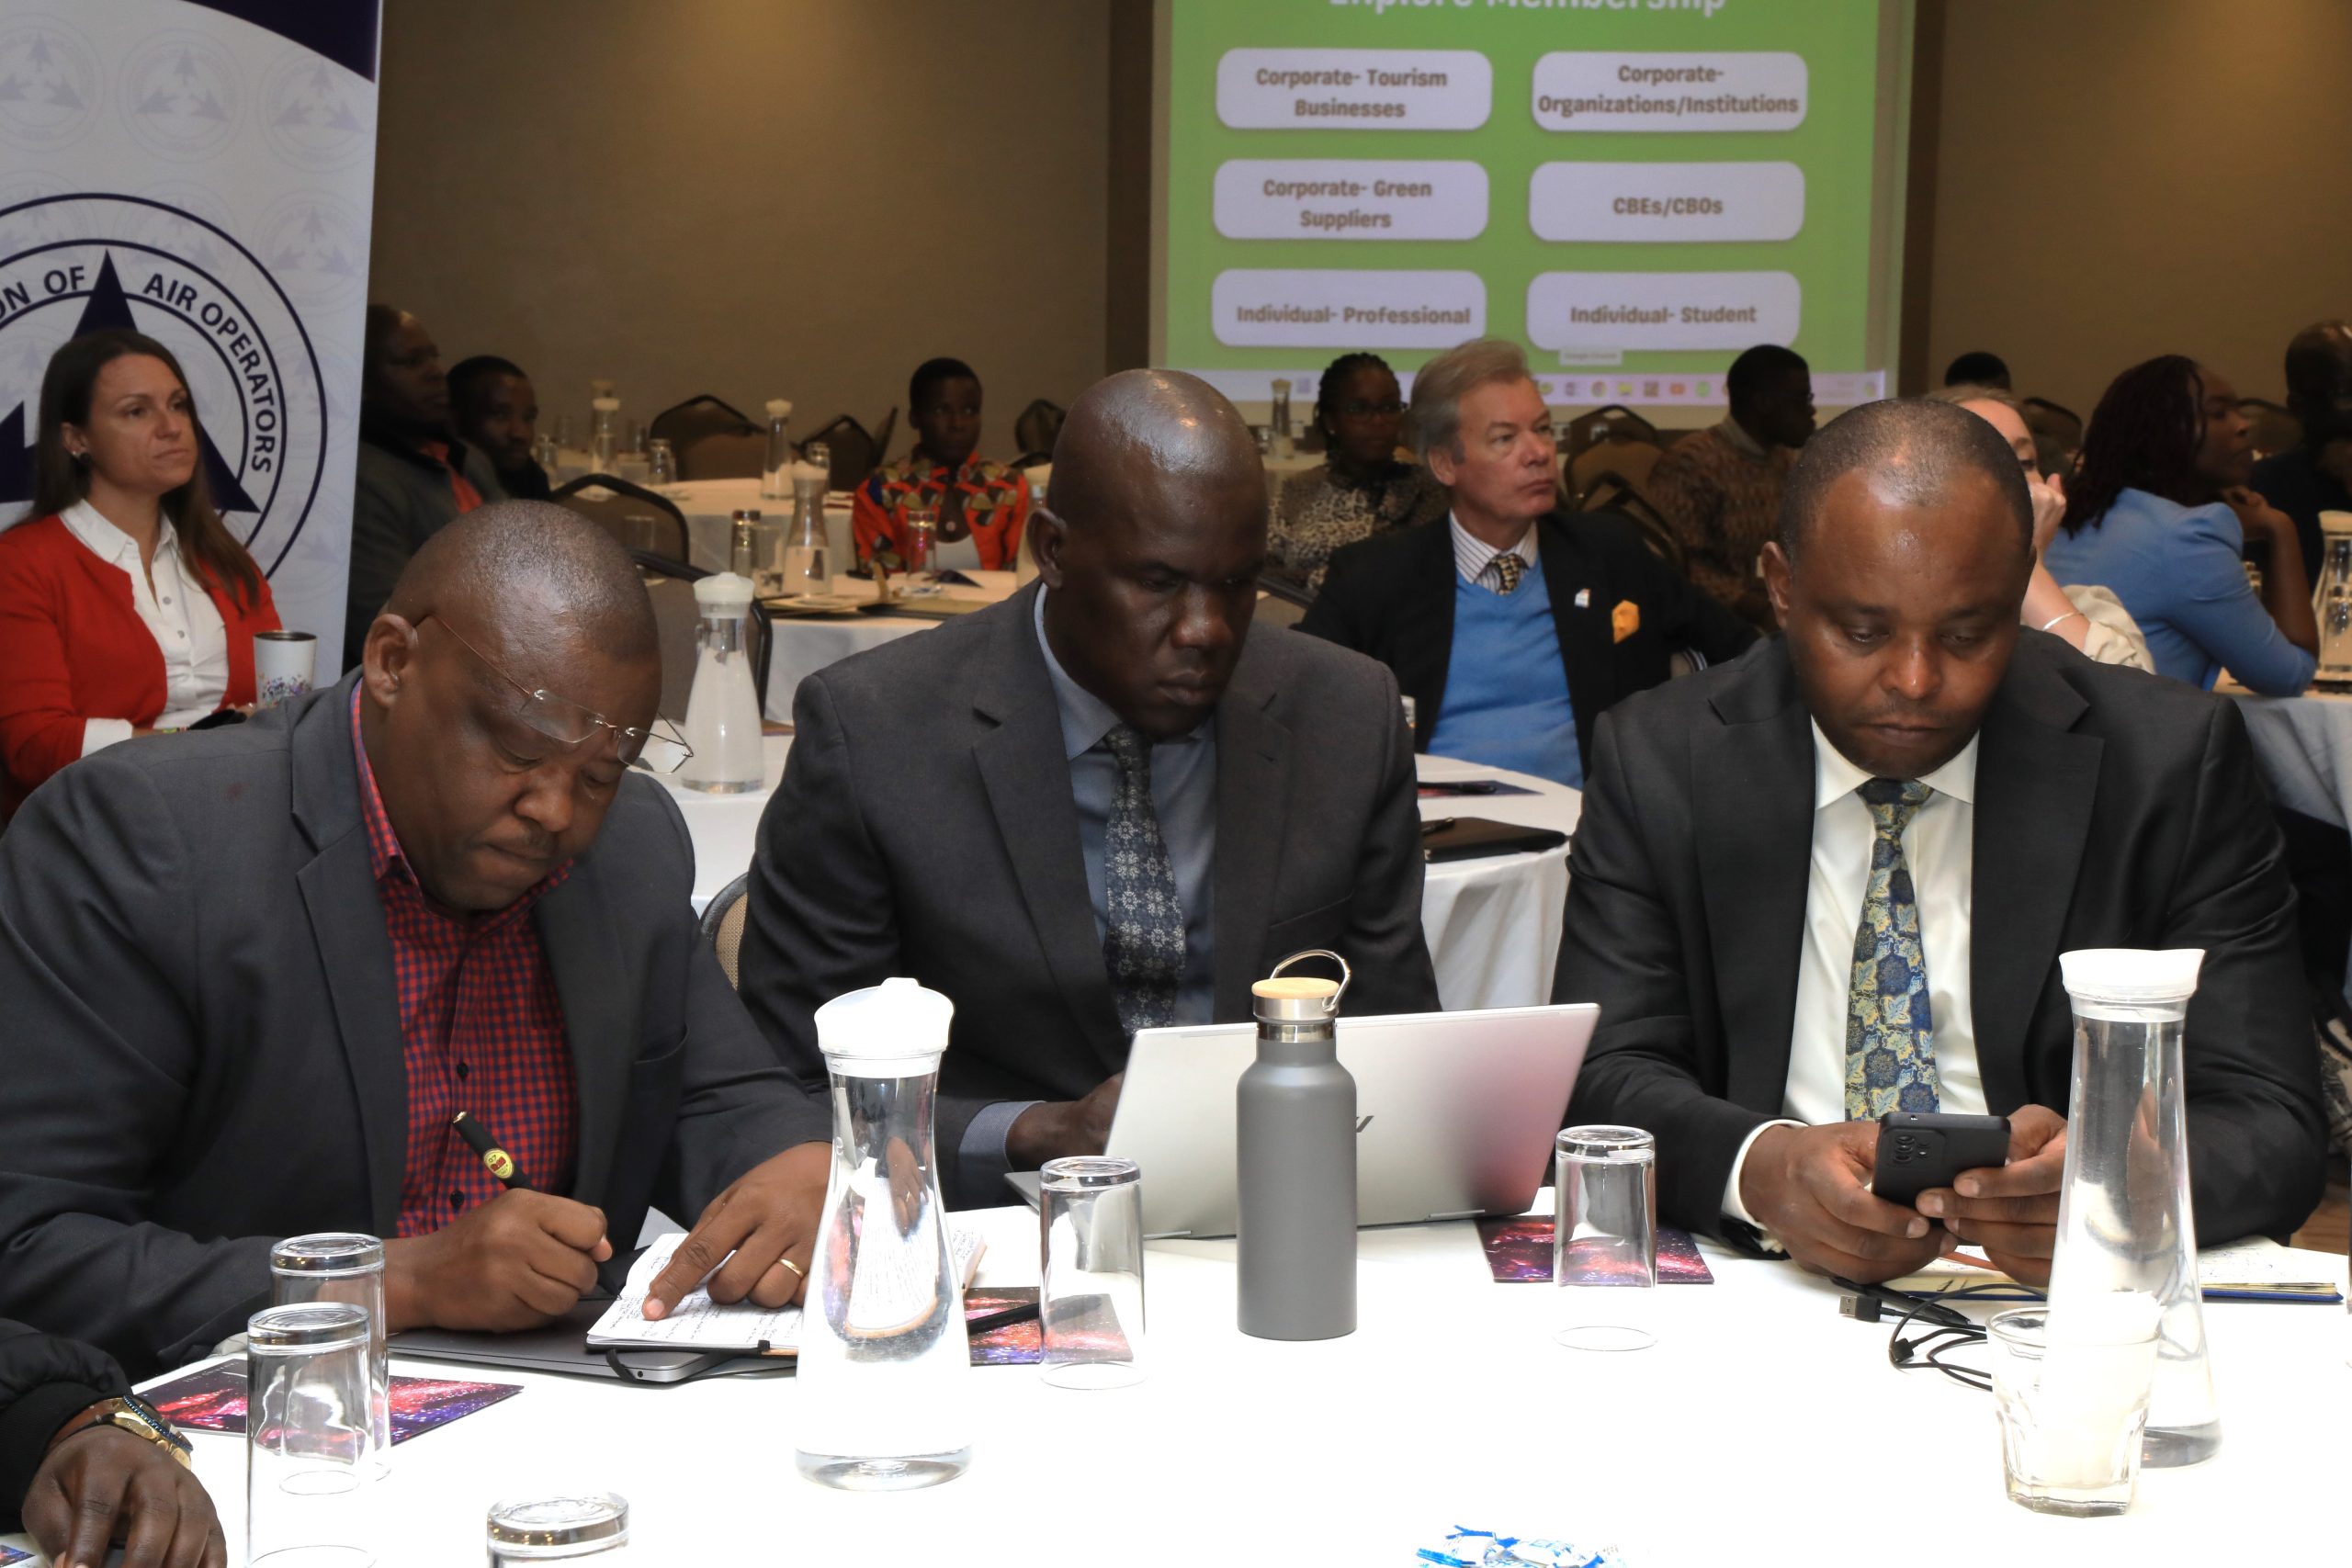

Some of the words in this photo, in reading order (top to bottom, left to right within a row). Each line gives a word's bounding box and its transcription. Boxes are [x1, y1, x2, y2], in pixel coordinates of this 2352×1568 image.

[1255, 67, 1361, 90] Corporate-
[1367, 67, 1448, 87] Tourism
[1618, 64, 1724, 86] Corporate-
[1294, 97, 1407, 118] Businesses
[1538, 94, 1800, 118] Organizations/Institutions
[1262, 178, 1368, 200] Corporate-
[1374, 179, 1433, 197] Green
[1612, 197, 1724, 218] CBEs/CBOs
[1299, 209, 1393, 231] Suppliers
[1236, 303, 1339, 323] Individual-
[1343, 305, 1472, 324] Professional
[1569, 304, 1675, 324] Individual-
[1680, 305, 1757, 324] Student
[0, 280, 31, 320] N
[43, 265, 85, 295] OF
[142, 273, 198, 312] AIR
[199, 301, 277, 473] OPERATORS
